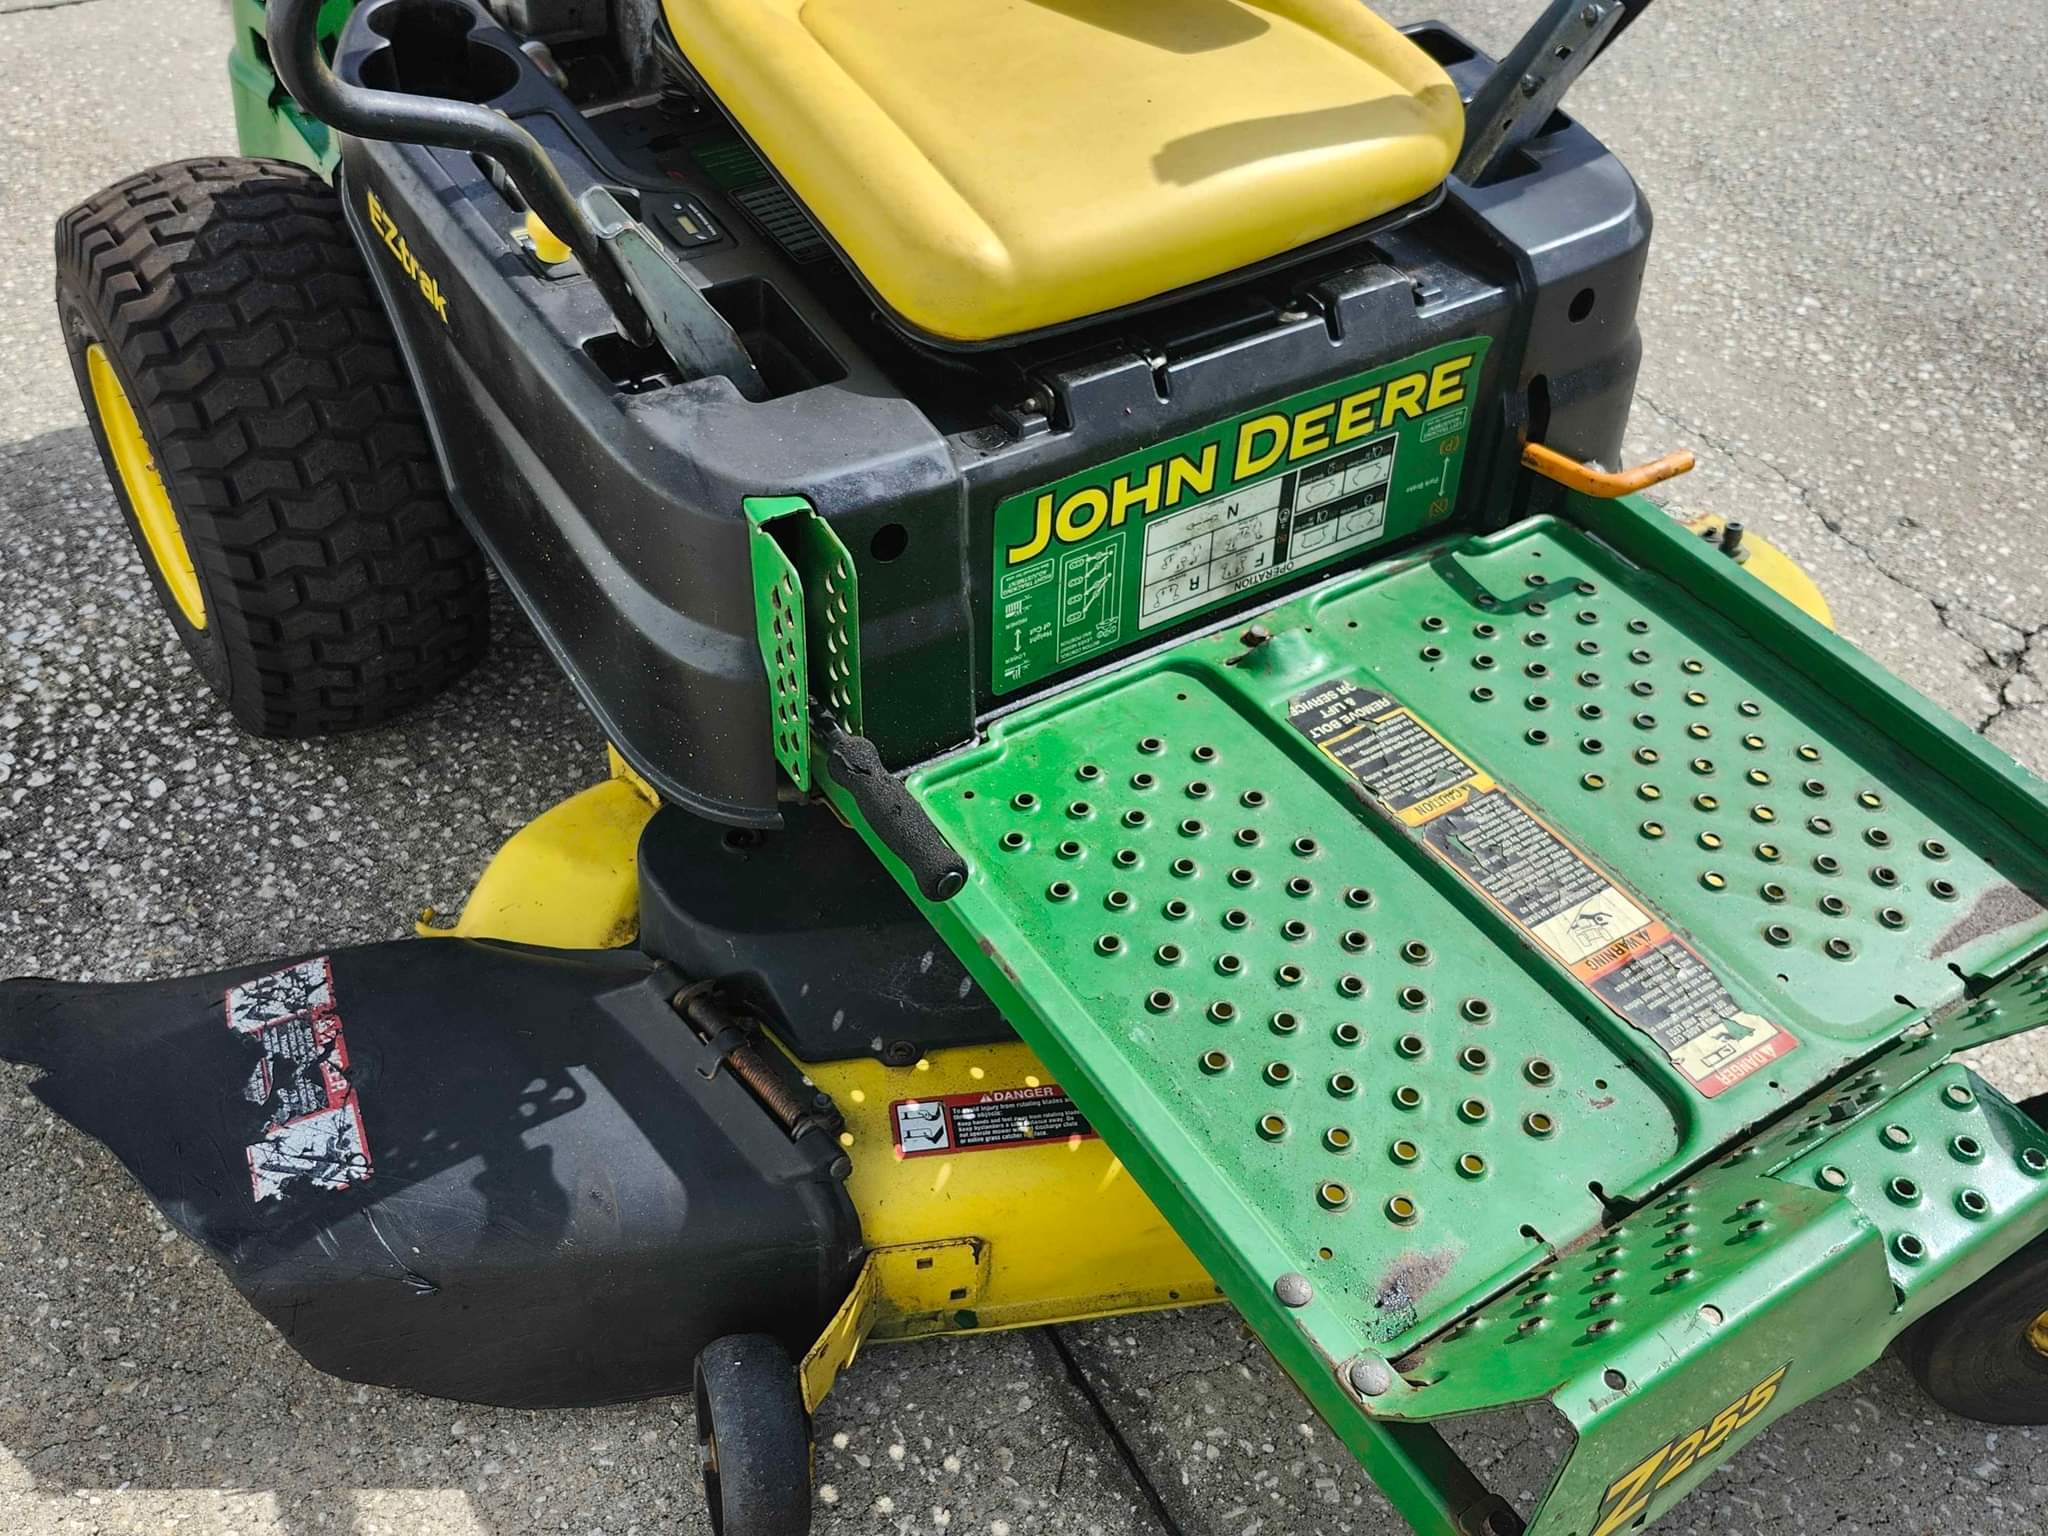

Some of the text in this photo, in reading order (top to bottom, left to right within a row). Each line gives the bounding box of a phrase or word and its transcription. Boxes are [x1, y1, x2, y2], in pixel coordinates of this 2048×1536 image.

[367, 191, 449, 324] EZtrak
[1009, 356, 1473, 565] JOHN DEERE
[1227, 502, 1239, 520] N
[1254, 552, 1264, 567] F
[1190, 576, 1199, 590] R
[1234, 562, 1294, 590] OPERATION
[1316, 696, 1357, 718] & LIFT
[1338, 696, 1391, 724] REMOVE
[1307, 718, 1343, 738] BOLT
[1413, 786, 1463, 817] CAUTION
[1584, 934, 1642, 972] WARNING
[1664, 1023, 1684, 1037] LEGS
[1713, 1051, 1768, 1086] DANGER
[993, 1087, 1053, 1101] DANGER
[1593, 1366, 1786, 1536] Z255
